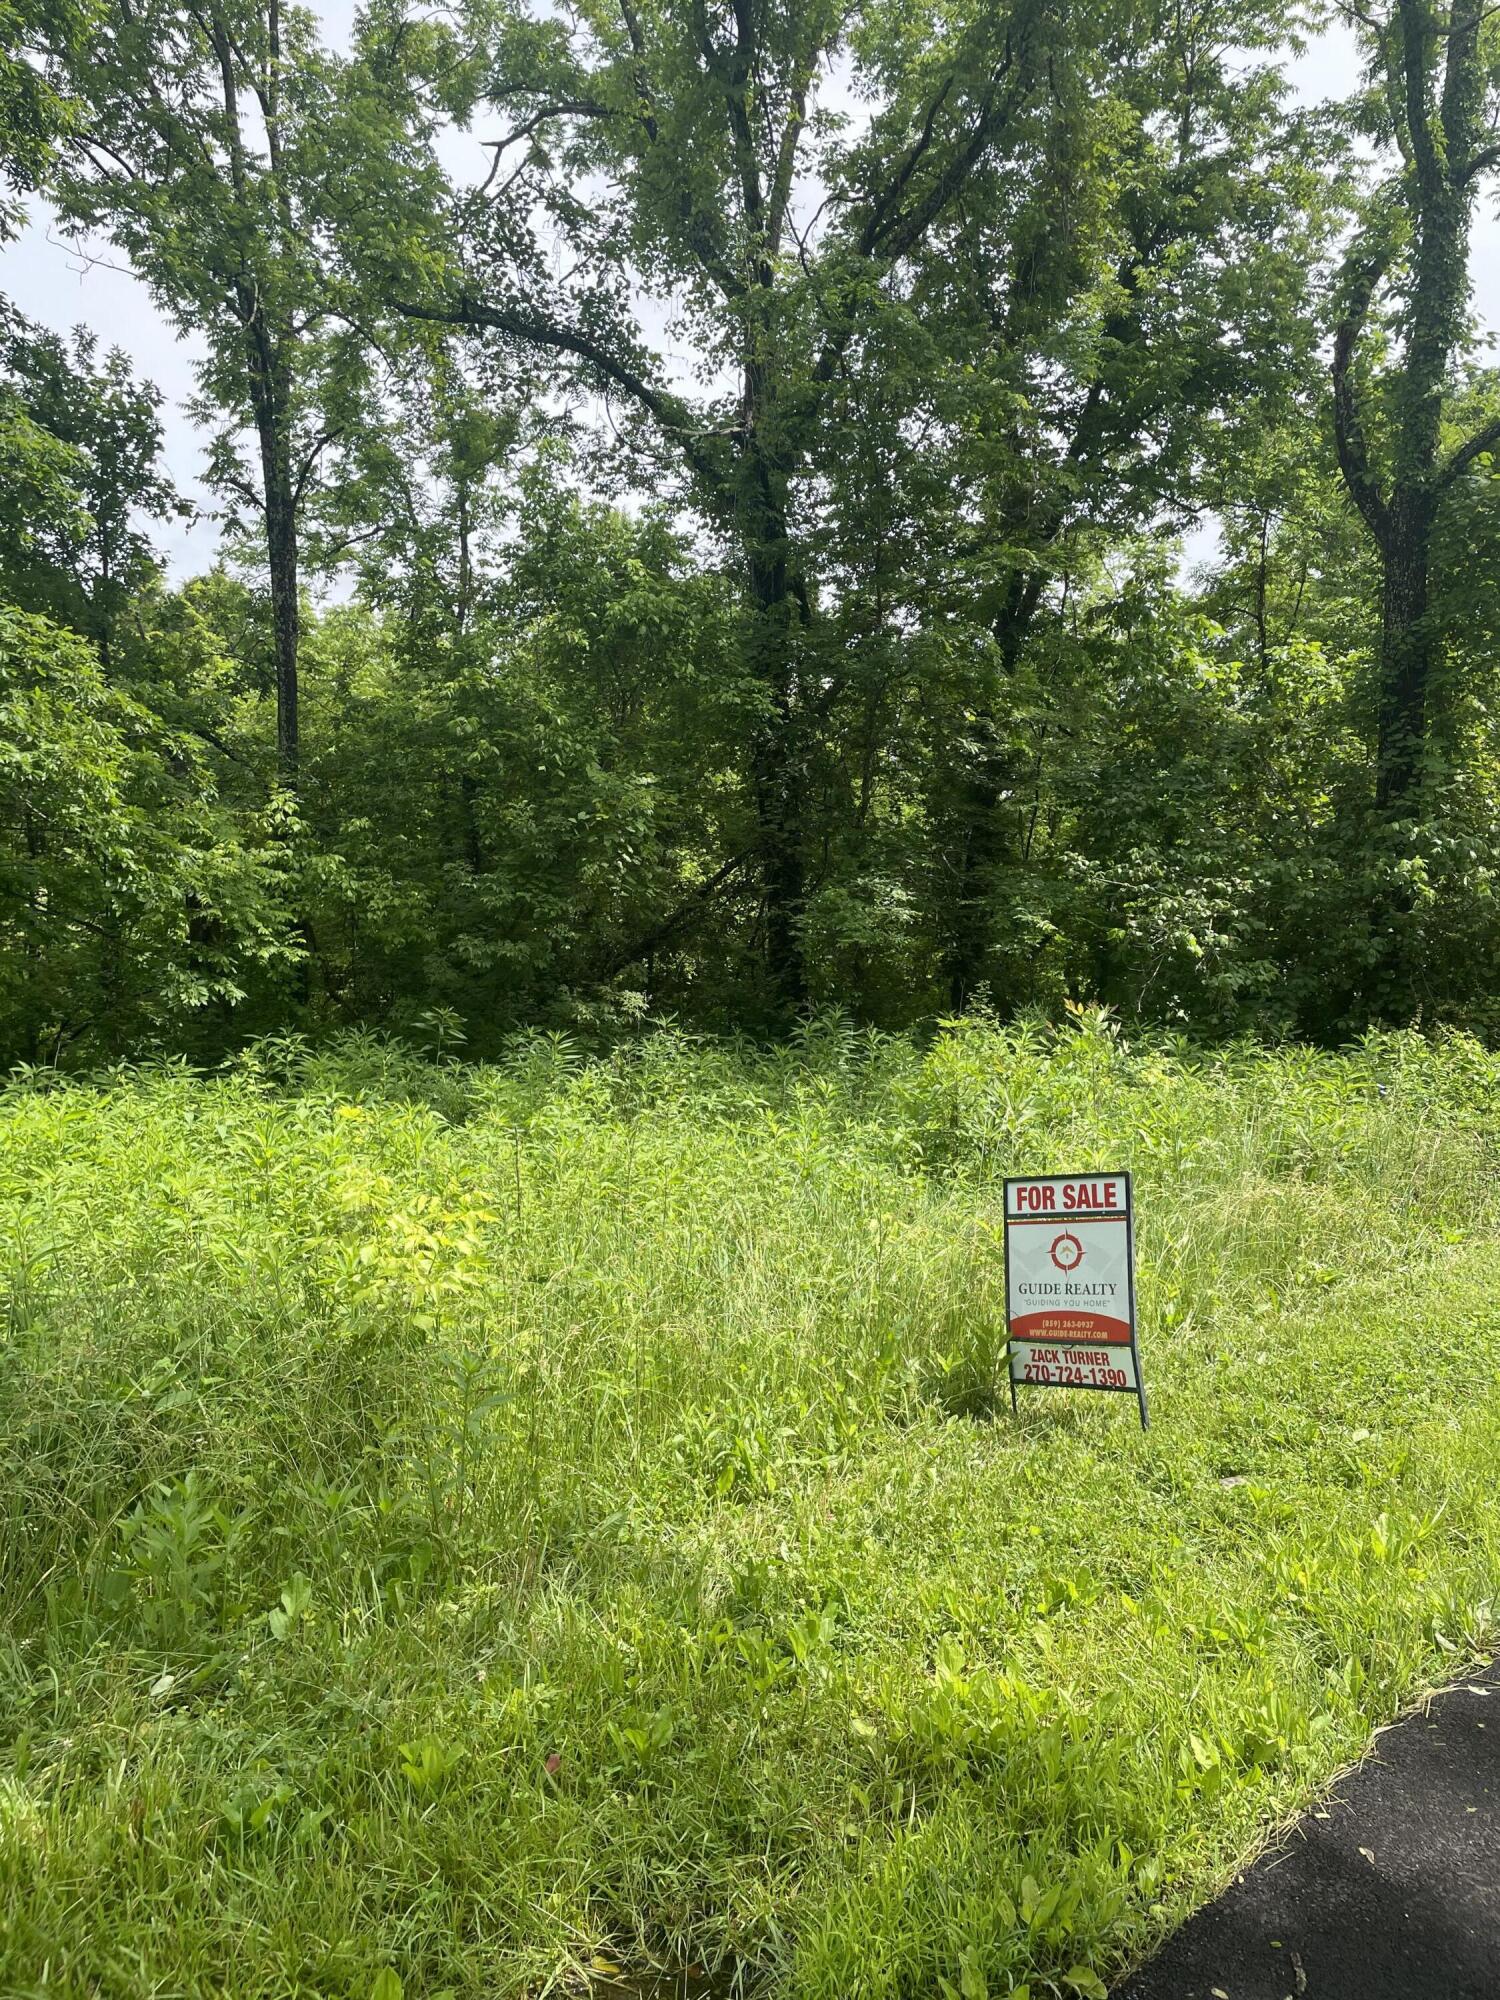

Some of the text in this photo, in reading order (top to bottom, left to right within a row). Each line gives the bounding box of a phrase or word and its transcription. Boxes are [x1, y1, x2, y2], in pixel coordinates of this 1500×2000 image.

[1017, 1182, 1117, 1211] FOR SALE
[1018, 1282, 1117, 1295] GUIDE REALTY
[1063, 1299, 1081, 1308] YOU
[1042, 1319, 1094, 1329] (859) 263-0937
[1029, 1329, 1108, 1339] WWW.GUIDE-REALTY.COM
[1030, 1348, 1110, 1366] ZACK TURNER
[1024, 1364, 1127, 1387] 270-724-1390
